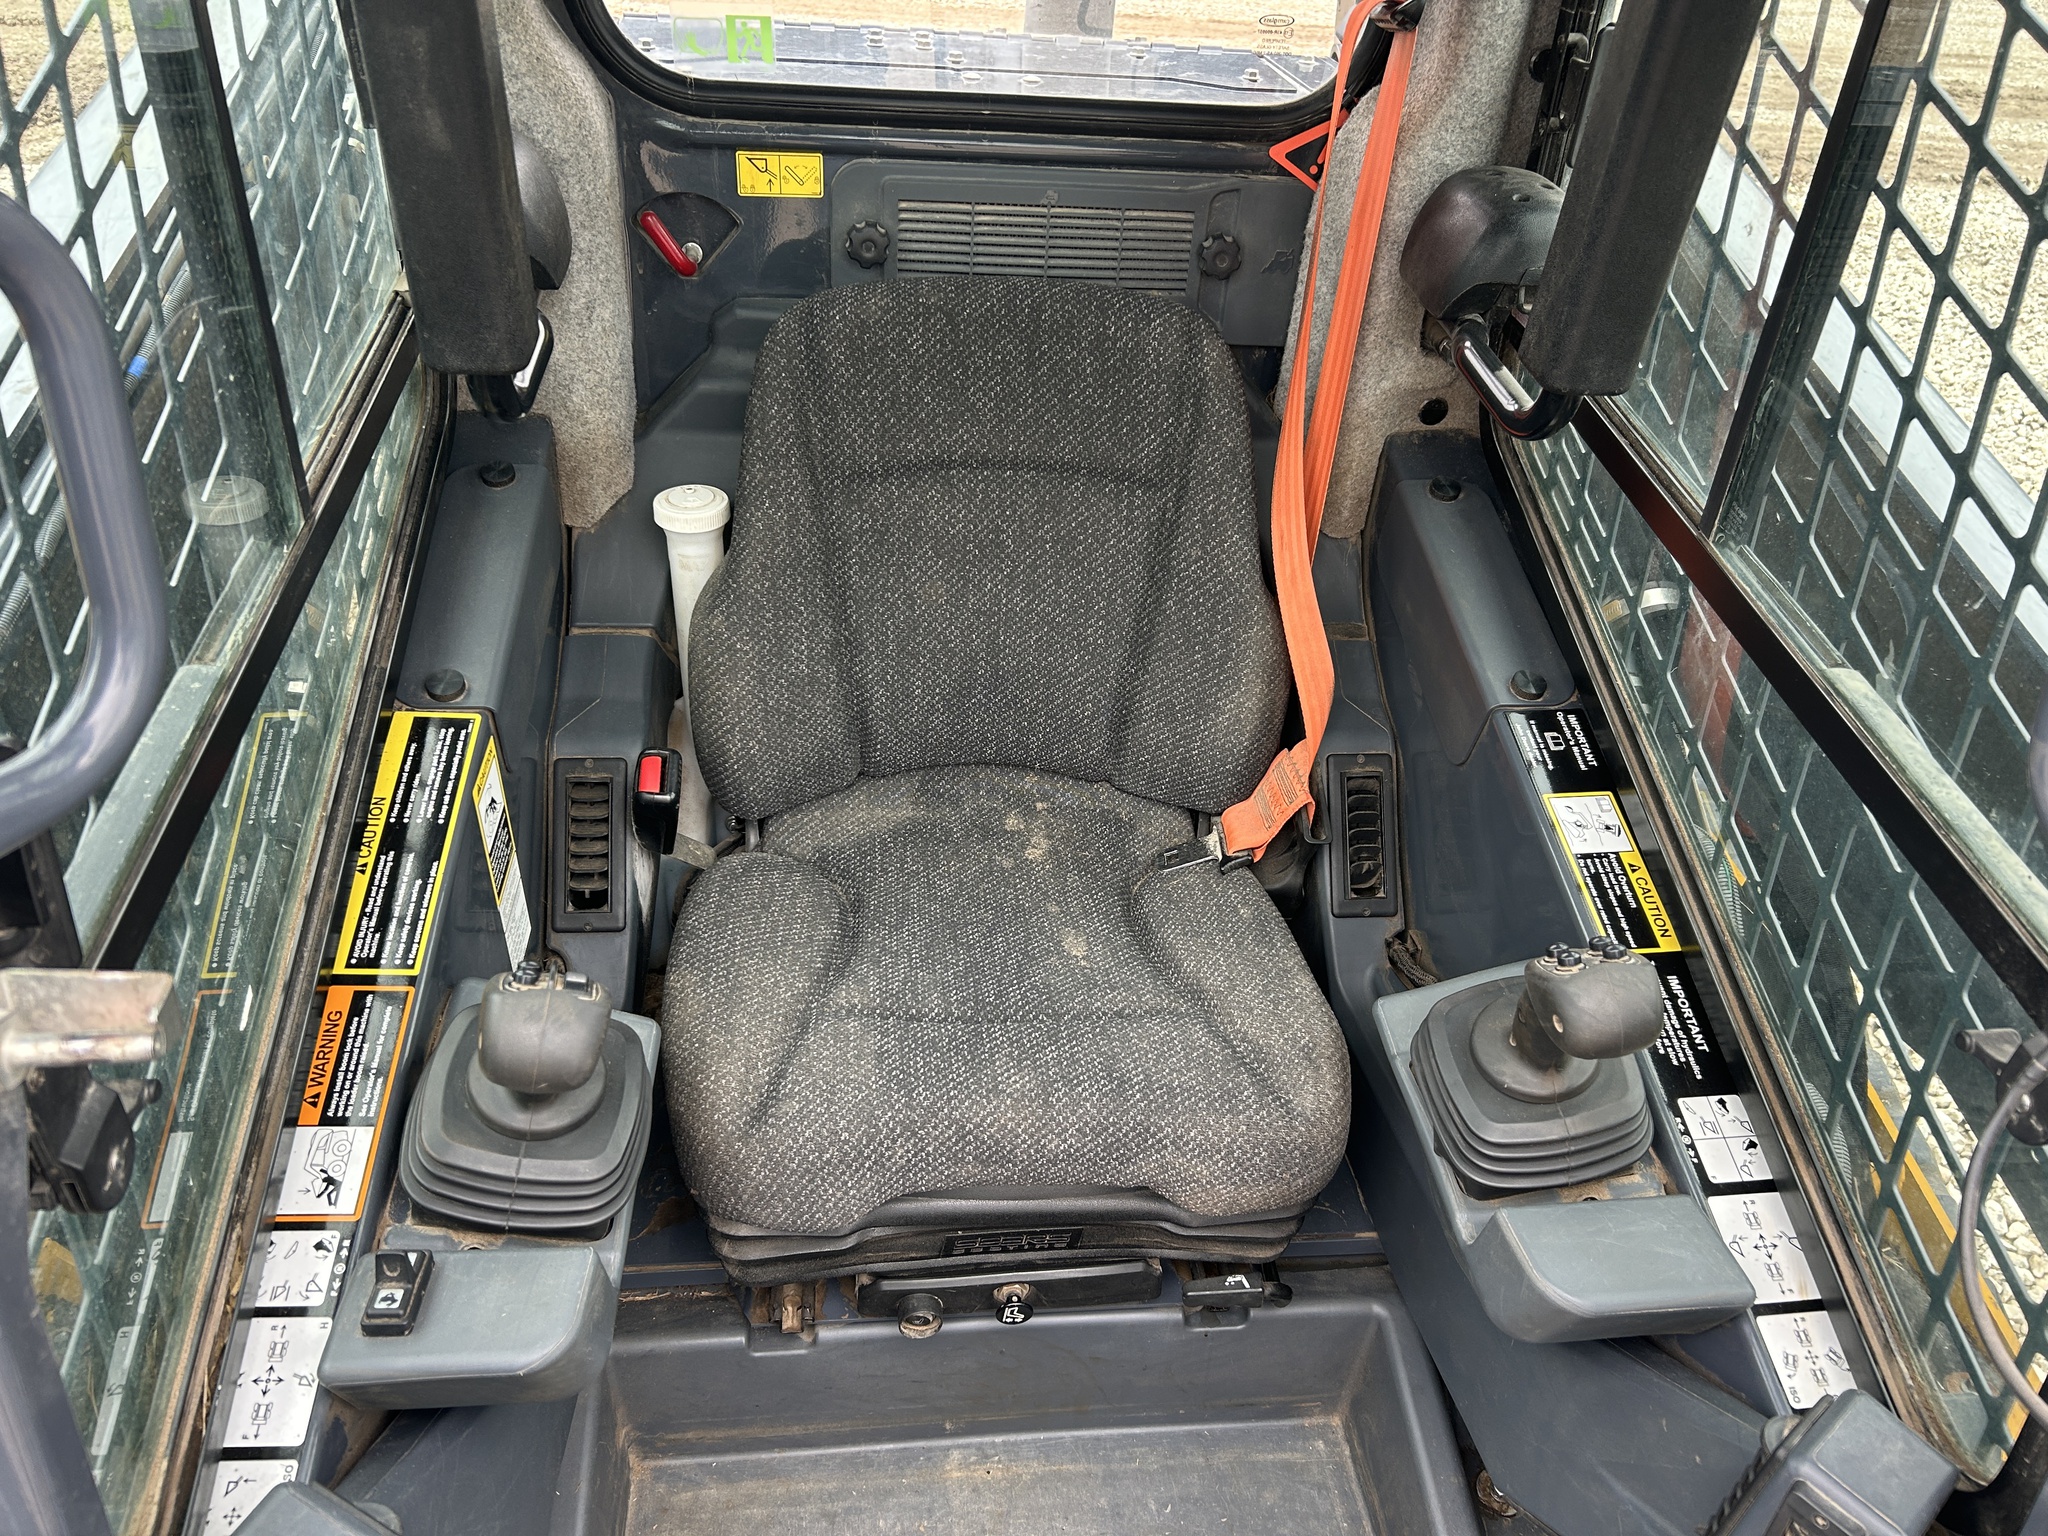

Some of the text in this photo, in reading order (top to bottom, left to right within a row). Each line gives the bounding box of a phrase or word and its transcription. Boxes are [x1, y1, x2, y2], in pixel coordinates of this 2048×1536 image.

[437, 727, 447, 739] stop
[1554, 711, 1588, 770] Operator's Manual
[1566, 714, 1598, 767] IMPORTANT
[439, 745, 449, 761] before
[454, 740, 464, 754] pedal
[402, 756, 413, 772] others
[430, 755, 440, 766] park
[436, 761, 446, 770] key
[448, 754, 462, 779] especially
[399, 772, 408, 782] and
[425, 766, 437, 784] engage
[432, 771, 443, 789] remove
[393, 782, 406, 803] children
[407, 788, 418, 801] carry
[429, 789, 438, 800] and
[441, 794, 450, 804] cab
[390, 803, 401, 817] Keep
[403, 801, 414, 817] Never
[417, 801, 427, 817] Lower
[425, 800, 436, 818] engine
[438, 804, 449, 818] Keep
[357, 796, 386, 858] CAUTION
[1577, 858, 1585, 866] Do
[1600, 857, 1612, 872] Carry
[1607, 872, 1618, 884] load
[1581, 867, 1590, 876] not
[1607, 852, 1638, 908] Avoid Overturn
[395, 882, 407, 905] function
[421, 883, 433, 907] windows
[1583, 876, 1598, 896] operate
[352, 854, 387, 957] AVOID INJURY Read and understand
[360, 850, 395, 957] Operator's Manual before operating this
[392, 906, 401, 916] and
[1593, 857, 1637, 948] Avoid steep slopes and high speed
[1593, 896, 1603, 909] over
[1633, 876, 1672, 938] CAUTION
[403, 902, 415, 924] devices
[418, 908, 427, 919] and
[1598, 909, 1610, 924] rated
[386, 917, 398, 940] location
[399, 924, 411, 942] safety
[412, 920, 424, 942] screens
[368, 931, 381, 958] machine.
[380, 941, 392, 958] Know
[394, 942, 406, 958] Keep
[408, 942, 419, 958] Keep
[1662, 998, 1682, 1029] damage
[1665, 974, 1710, 1052] IMPORTANT
[1662, 1037, 1672, 1046] at
[1675, 1029, 1687, 1038] of
[306, 1010, 343, 1088] WARNING
[335, 993, 374, 1116] working on or around this machine with
[1665, 1046, 1681, 1066] slow
[326, 1016, 359, 1117] Always install boom lock before
[358, 1005, 394, 1116] See Operator's Manual for complete
[1679, 1038, 1704, 1080] hydraulics
[344, 1041, 370, 1117] the loader boom raised.
[320, 1321, 330, 1330] H
[1788, 1385, 1801, 1404] ISO
[282, 1464, 295, 1482] SO
